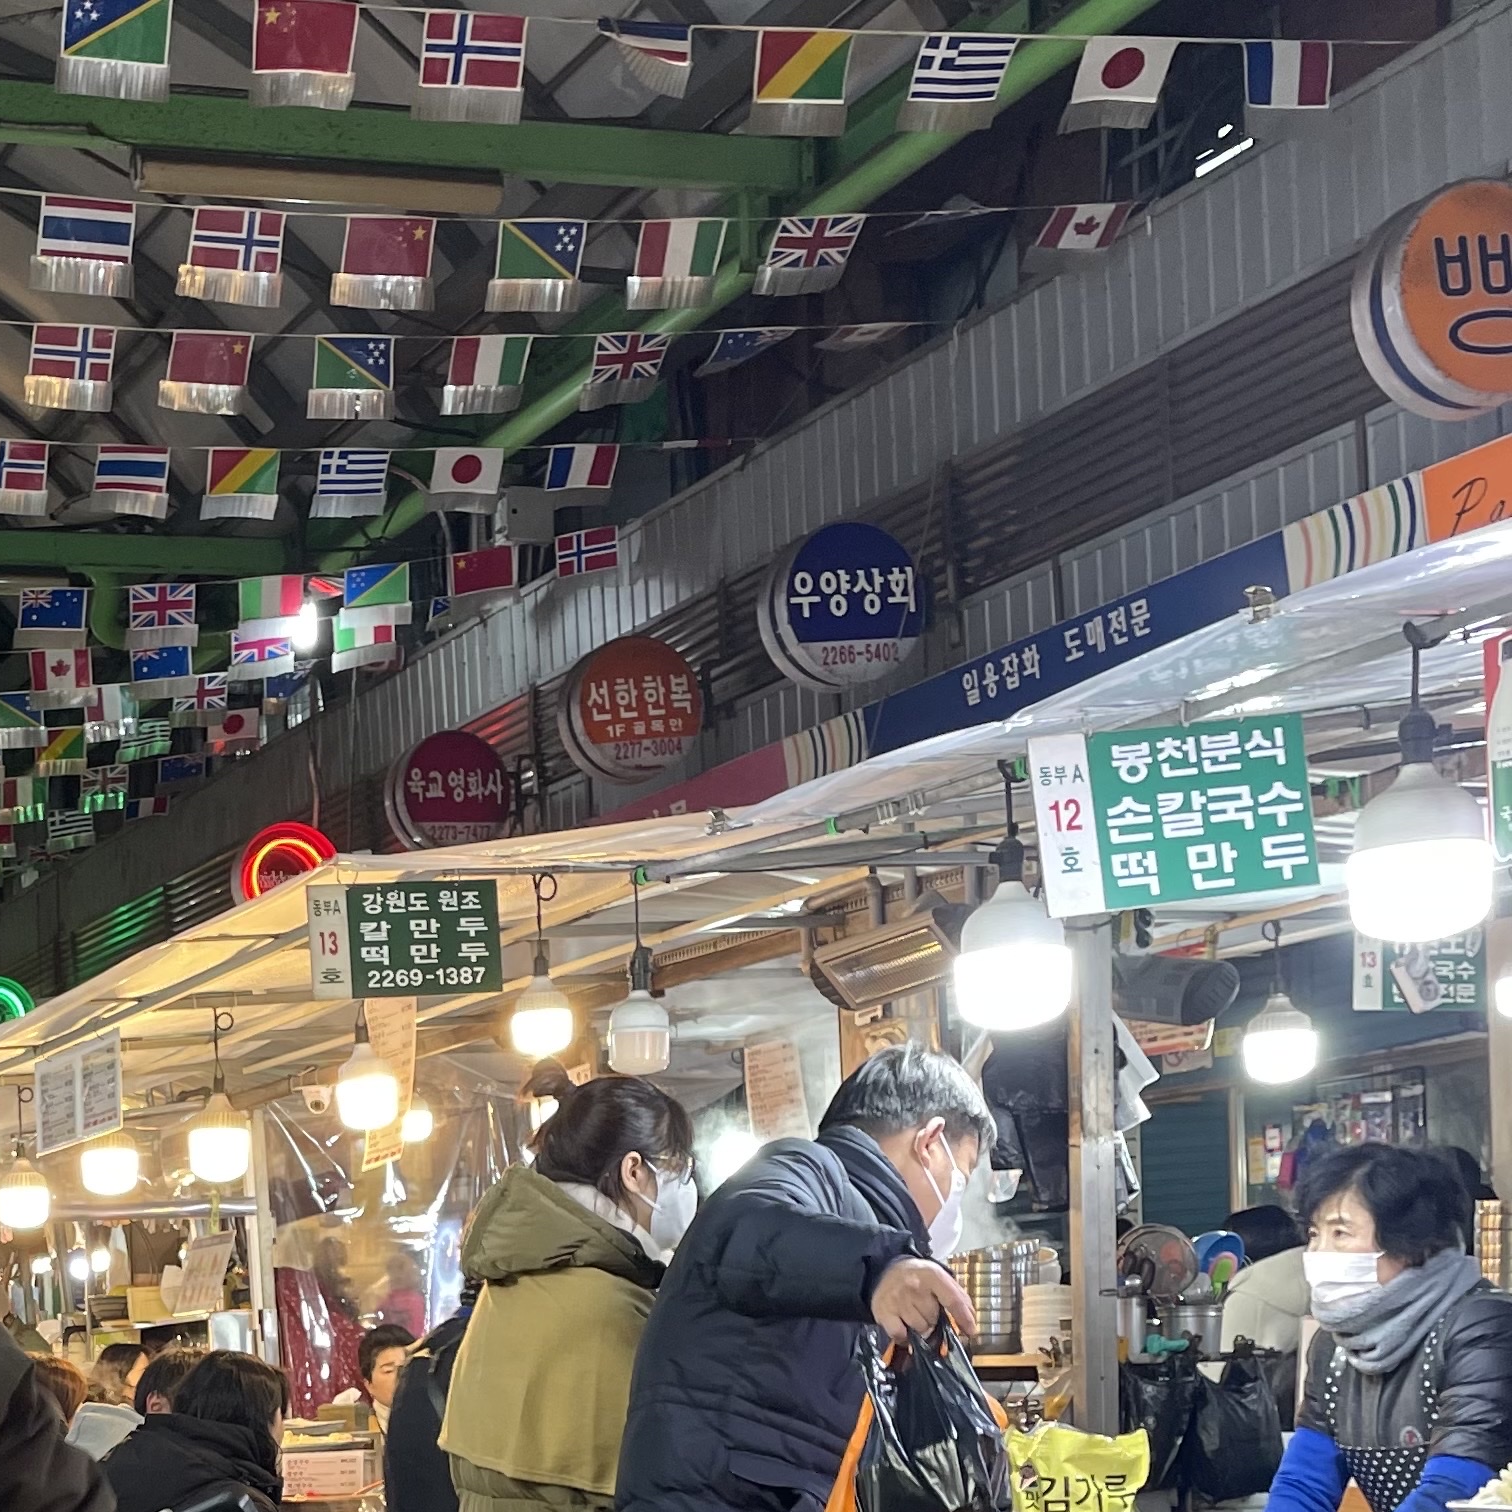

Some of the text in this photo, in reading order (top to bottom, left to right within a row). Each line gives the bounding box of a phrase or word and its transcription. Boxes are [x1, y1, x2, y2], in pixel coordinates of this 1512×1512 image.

[790, 566, 916, 618] 우양상회
[961, 645, 1041, 706] 일용잡화
[1064, 602, 1152, 663] 도매전문
[586, 673, 692, 722] 선한한복
[606, 723, 627, 738] 1F
[614, 739, 683, 760] 2277-3004
[1110, 726, 1287, 783] 봉천분식
[406, 767, 504, 805] 육교영화사
[1048, 798, 1082, 832] 12
[1106, 781, 1303, 844] 손칼국수
[1061, 848, 1083, 874] 호
[362, 889, 482, 914] 강원도 원조
[319, 931, 338, 955] 13
[1360, 951, 1377, 968] 13
[320, 967, 344, 984] 호
[368, 967, 485, 988] 2269-1387
[1041, 1474, 1135, 1512] 김가루
